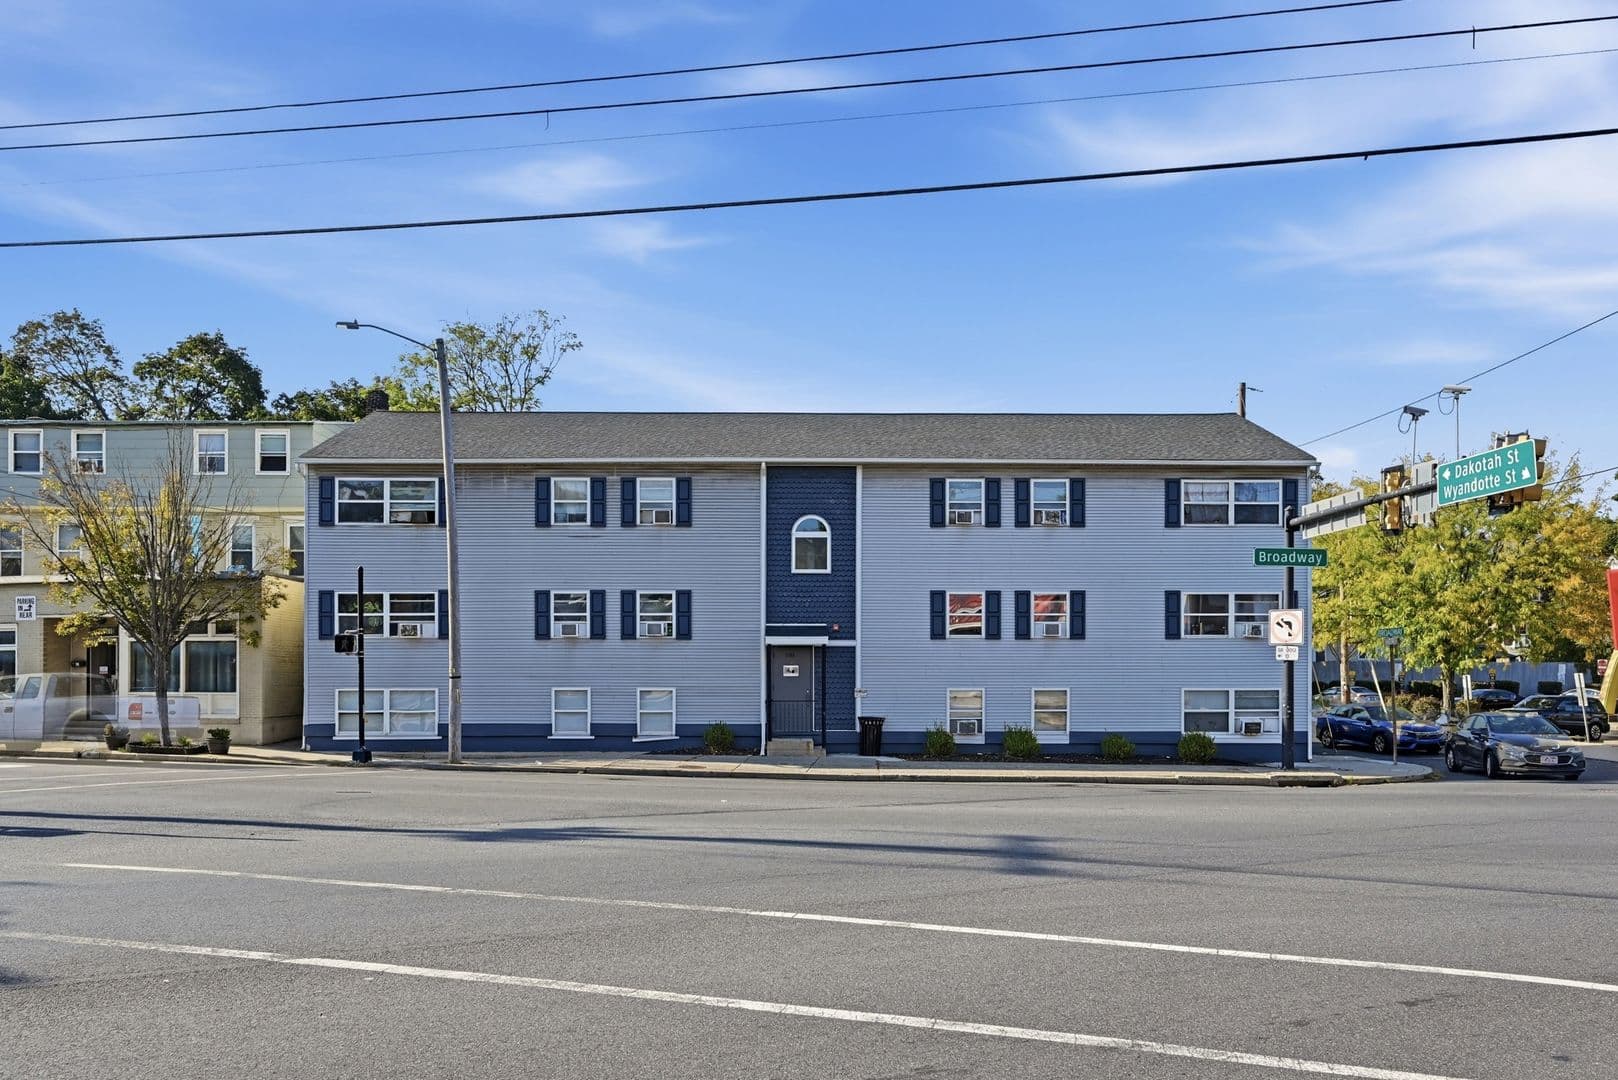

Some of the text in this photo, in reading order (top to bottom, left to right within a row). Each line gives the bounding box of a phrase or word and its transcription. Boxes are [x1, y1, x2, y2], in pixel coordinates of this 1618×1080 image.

[1455, 448, 1519, 479] Dakotah St
[1443, 468, 1517, 501] Wyandotte St
[1259, 551, 1322, 566] Broadway
